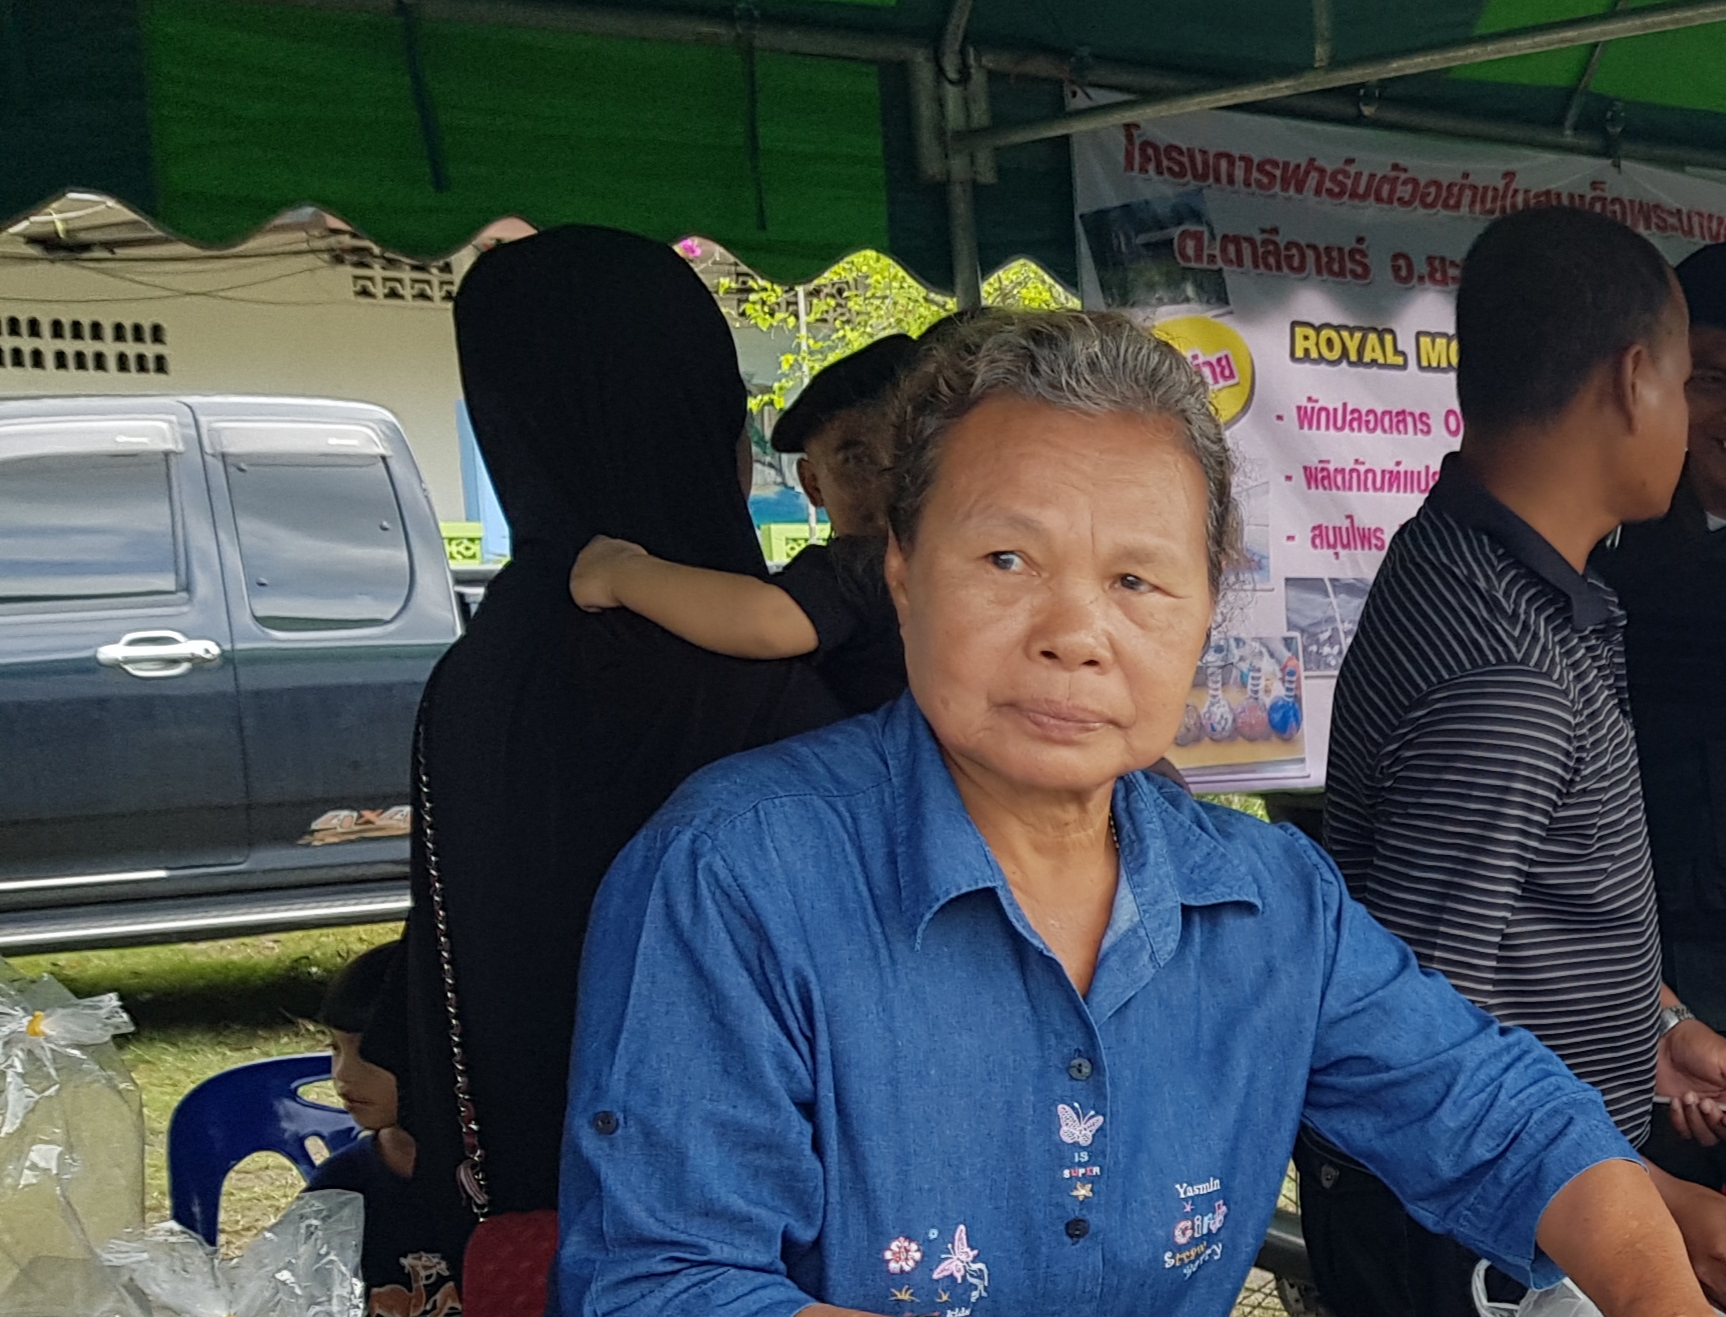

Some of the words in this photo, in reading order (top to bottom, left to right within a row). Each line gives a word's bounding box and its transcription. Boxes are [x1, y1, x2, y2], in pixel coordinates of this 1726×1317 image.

[1292, 324, 1406, 368] ROYAL
[1062, 1165, 1101, 1179] SUPER
[1175, 1176, 1221, 1199] Yasmin
